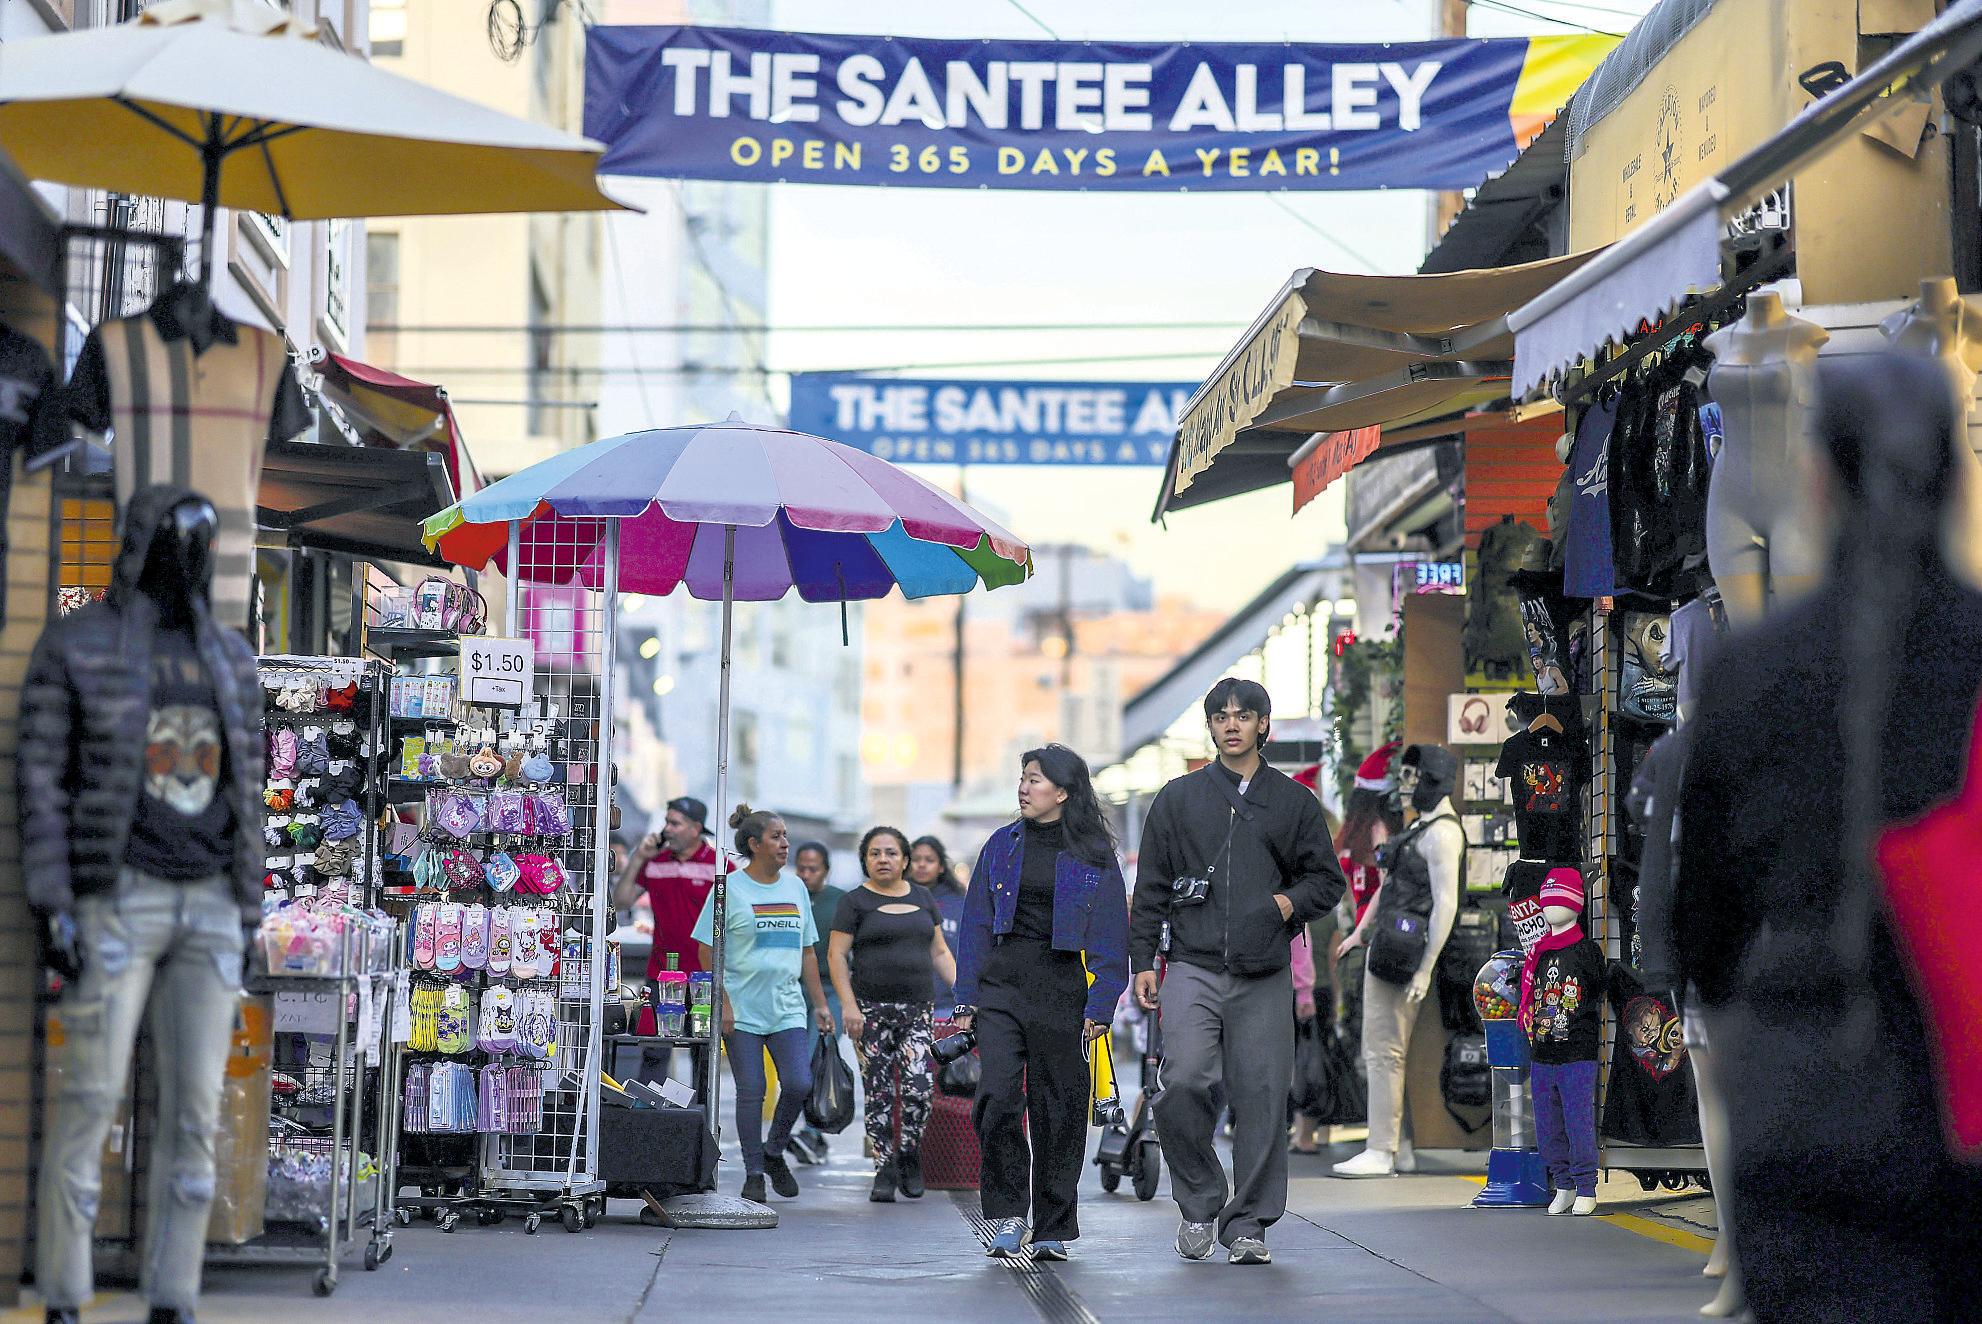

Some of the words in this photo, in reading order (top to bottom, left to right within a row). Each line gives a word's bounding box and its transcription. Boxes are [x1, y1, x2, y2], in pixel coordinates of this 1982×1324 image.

[661, 47, 820, 123] THE
[835, 54, 1153, 131] SANTEE
[1168, 61, 1442, 131] ALLEY
[730, 137, 862, 170] OPEN
[888, 144, 971, 173] 365
[998, 147, 1117, 176] DAYS
[1142, 148, 1171, 177] A
[1195, 147, 1340, 176] YEAR!
[829, 383, 929, 432] THE
[934, 384, 1127, 434] SANTEE
[471, 650, 524, 673] $1.50
